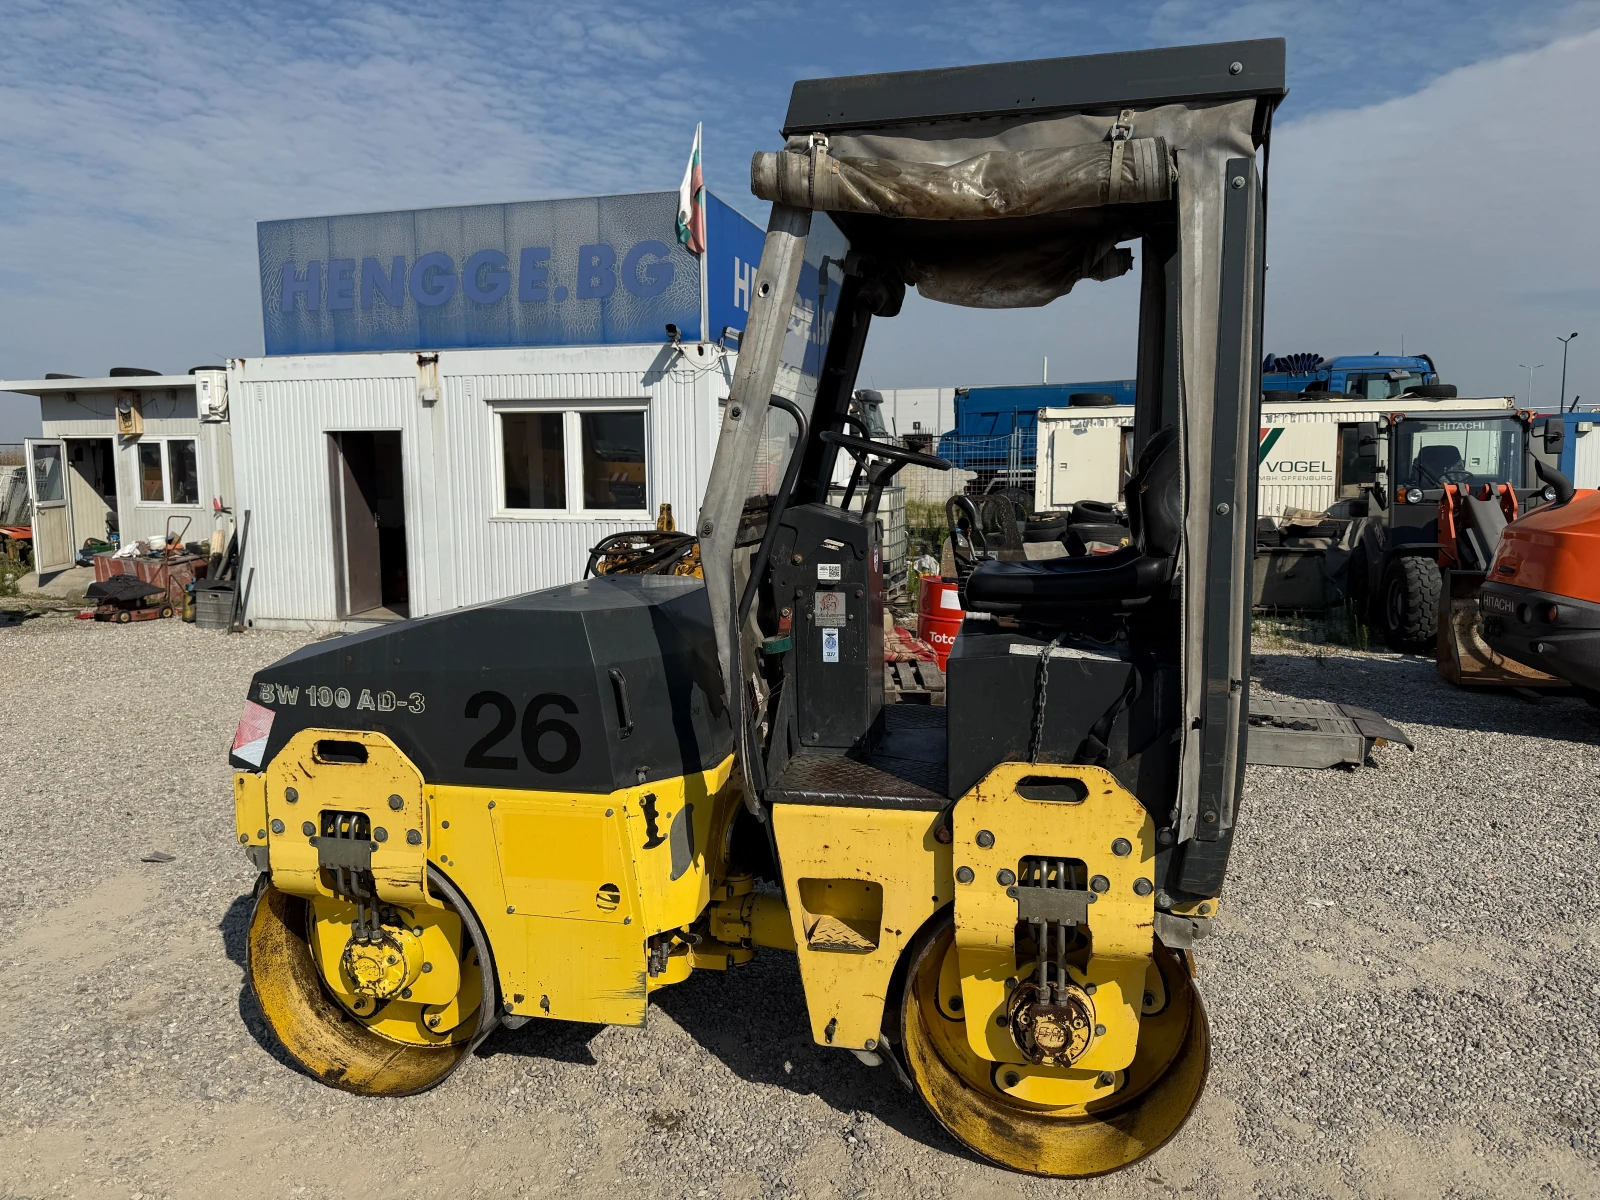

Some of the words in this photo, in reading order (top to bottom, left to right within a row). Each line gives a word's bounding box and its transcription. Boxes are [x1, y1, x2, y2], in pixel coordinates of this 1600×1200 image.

[283, 240, 675, 312] HENGGE.BG
[1438, 422, 1485, 430] HITACHI
[1266, 461, 1332, 473] VOGEL
[1483, 595, 1514, 612] HITACHI
[258, 682, 300, 706] BW
[305, 685, 351, 709] 100
[356, 689, 426, 714] AD-3
[464, 690, 582, 775] 26
